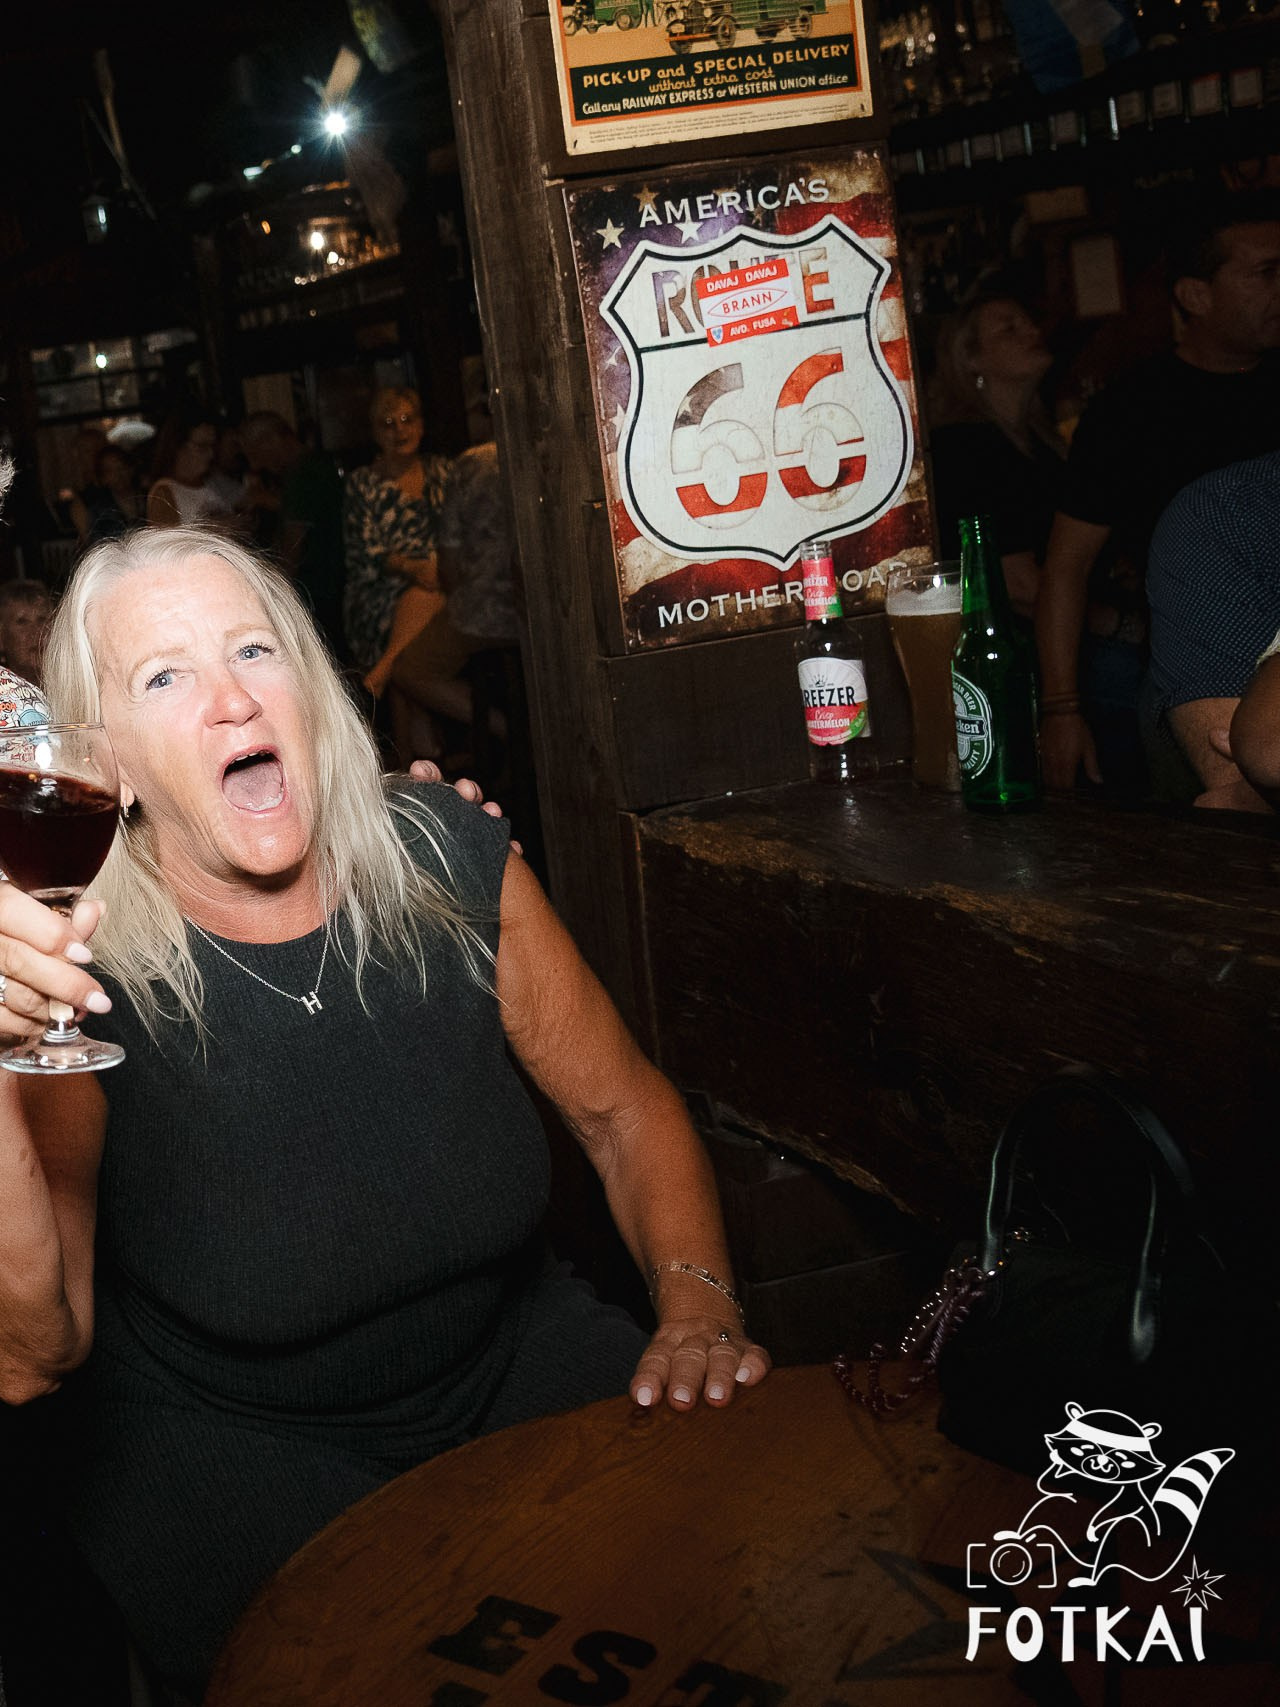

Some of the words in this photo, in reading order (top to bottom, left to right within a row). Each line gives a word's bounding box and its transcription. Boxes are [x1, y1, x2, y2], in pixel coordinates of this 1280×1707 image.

[583, 68, 651, 88] PICK-UP
[657, 64, 685, 78] and
[694, 54, 766, 74] SPECIAL
[773, 44, 850, 65] DELIVERY
[648, 76, 696, 93] without
[704, 73, 739, 86] extra
[745, 67, 775, 80] cost
[582, 102, 601, 115] Call
[601, 102, 621, 112] any
[622, 93, 667, 110] RAILWAY
[669, 87, 714, 104] EXPRESS
[716, 89, 727, 98] or
[728, 81, 777, 97] WESTERN
[780, 75, 816, 90] UNION
[818, 74, 849, 86] office
[639, 177, 831, 229] AMERICA'S
[651, 246, 836, 338] ROE
[706, 273, 739, 293] DAVAJ
[745, 266, 778, 283] DAVAJ
[722, 291, 773, 315] BRANN
[753, 316, 777, 331] FUSA
[670, 346, 867, 530] 66
[658, 579, 804, 628] MOTHER
[838, 562, 912, 593] OAD
[803, 576, 828, 587] REEZER
[805, 686, 857, 708] REEZER
